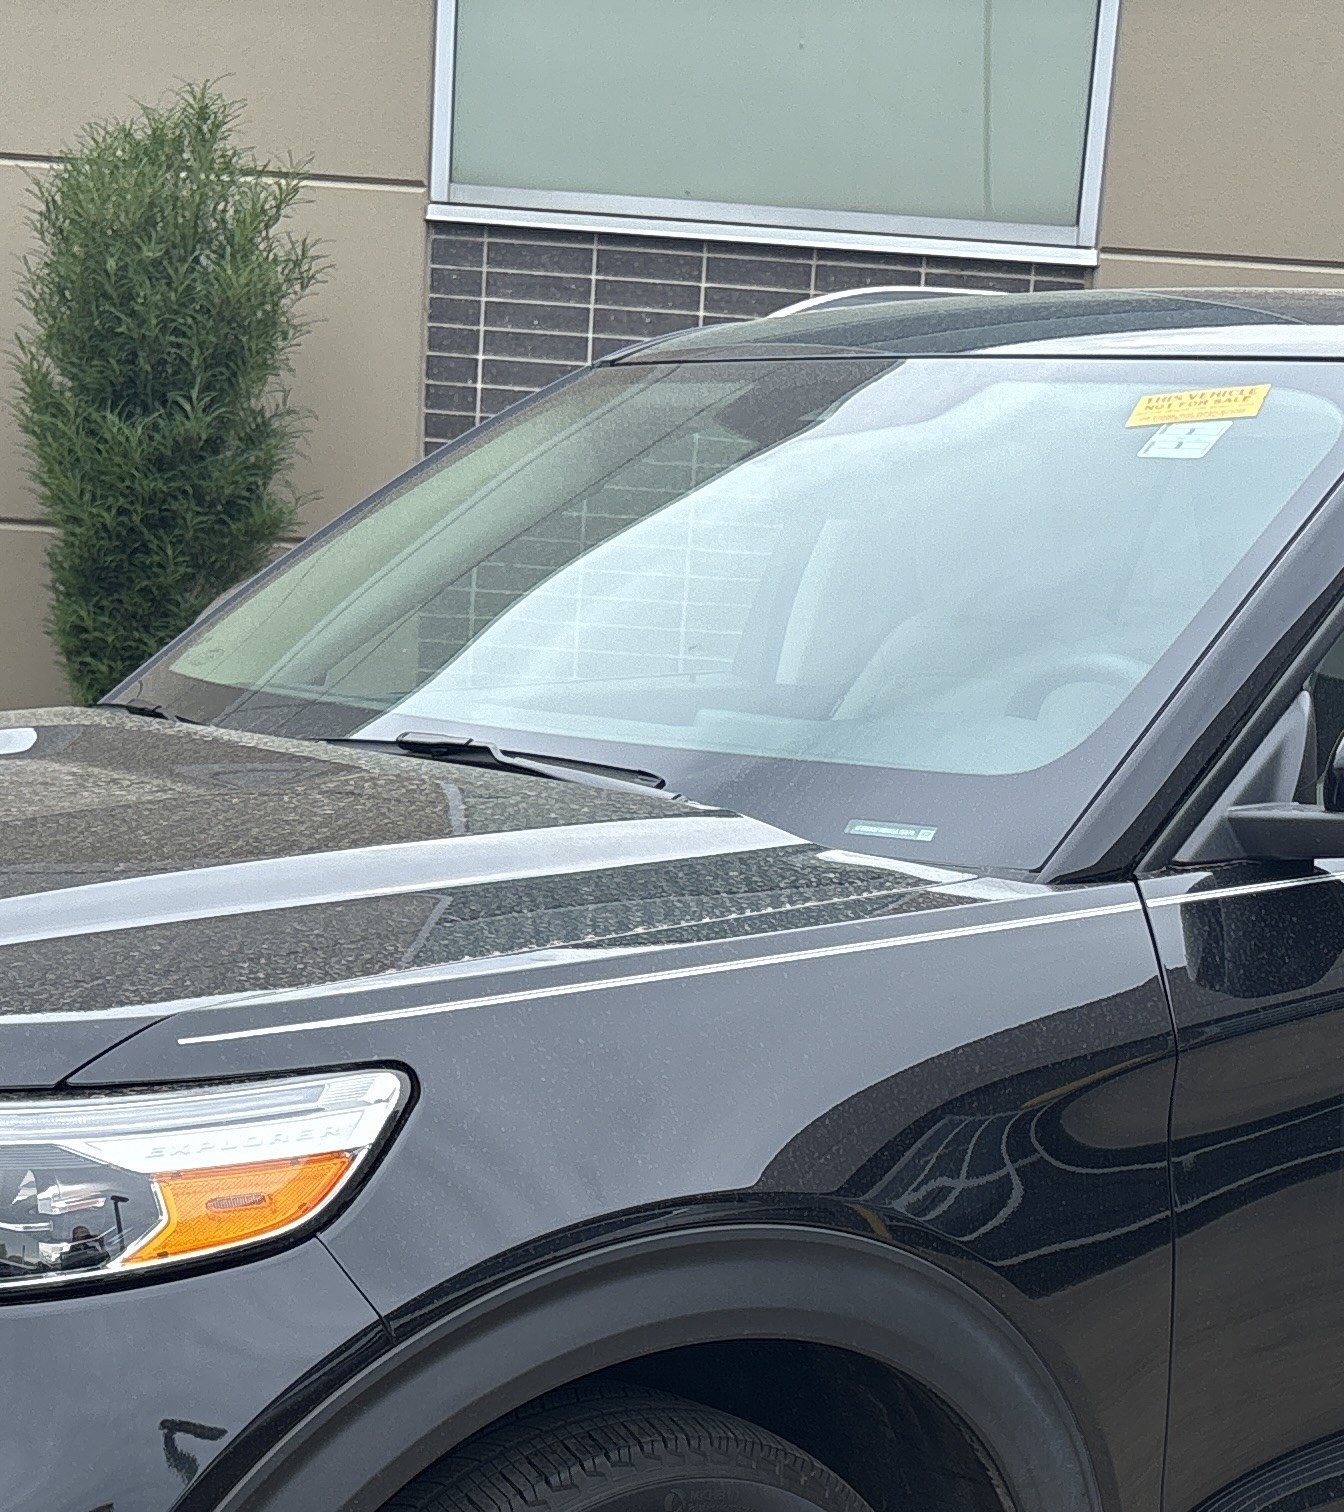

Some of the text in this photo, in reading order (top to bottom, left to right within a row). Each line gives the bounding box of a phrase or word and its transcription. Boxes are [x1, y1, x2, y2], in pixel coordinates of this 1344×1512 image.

[1189, 388, 1258, 400] VEHICLE
[1144, 395, 1253, 412] NOT FOR SALE
[145, 1126, 342, 1159] EXPLORER
